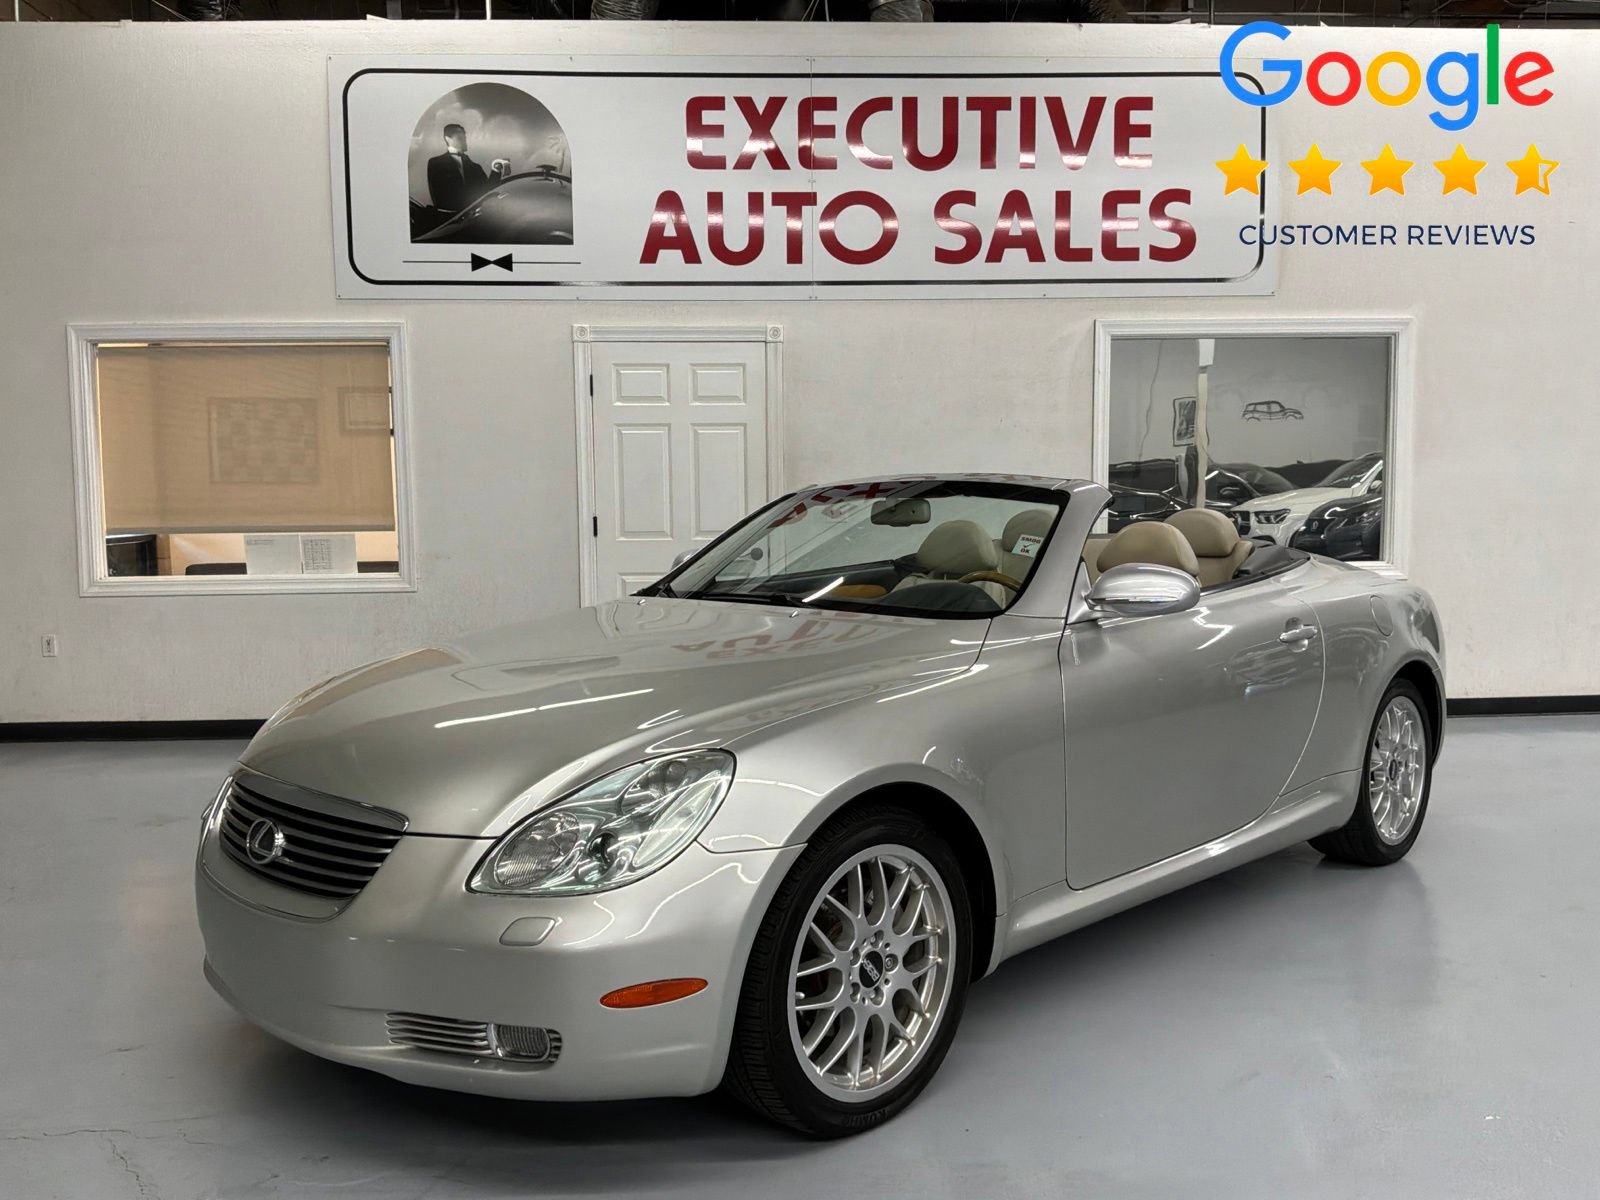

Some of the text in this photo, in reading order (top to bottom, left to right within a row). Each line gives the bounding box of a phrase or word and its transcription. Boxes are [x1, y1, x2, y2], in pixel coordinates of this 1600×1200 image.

[685, 96, 1154, 171] EXECUTIVE
[640, 188, 1196, 267] AUTO SALES
